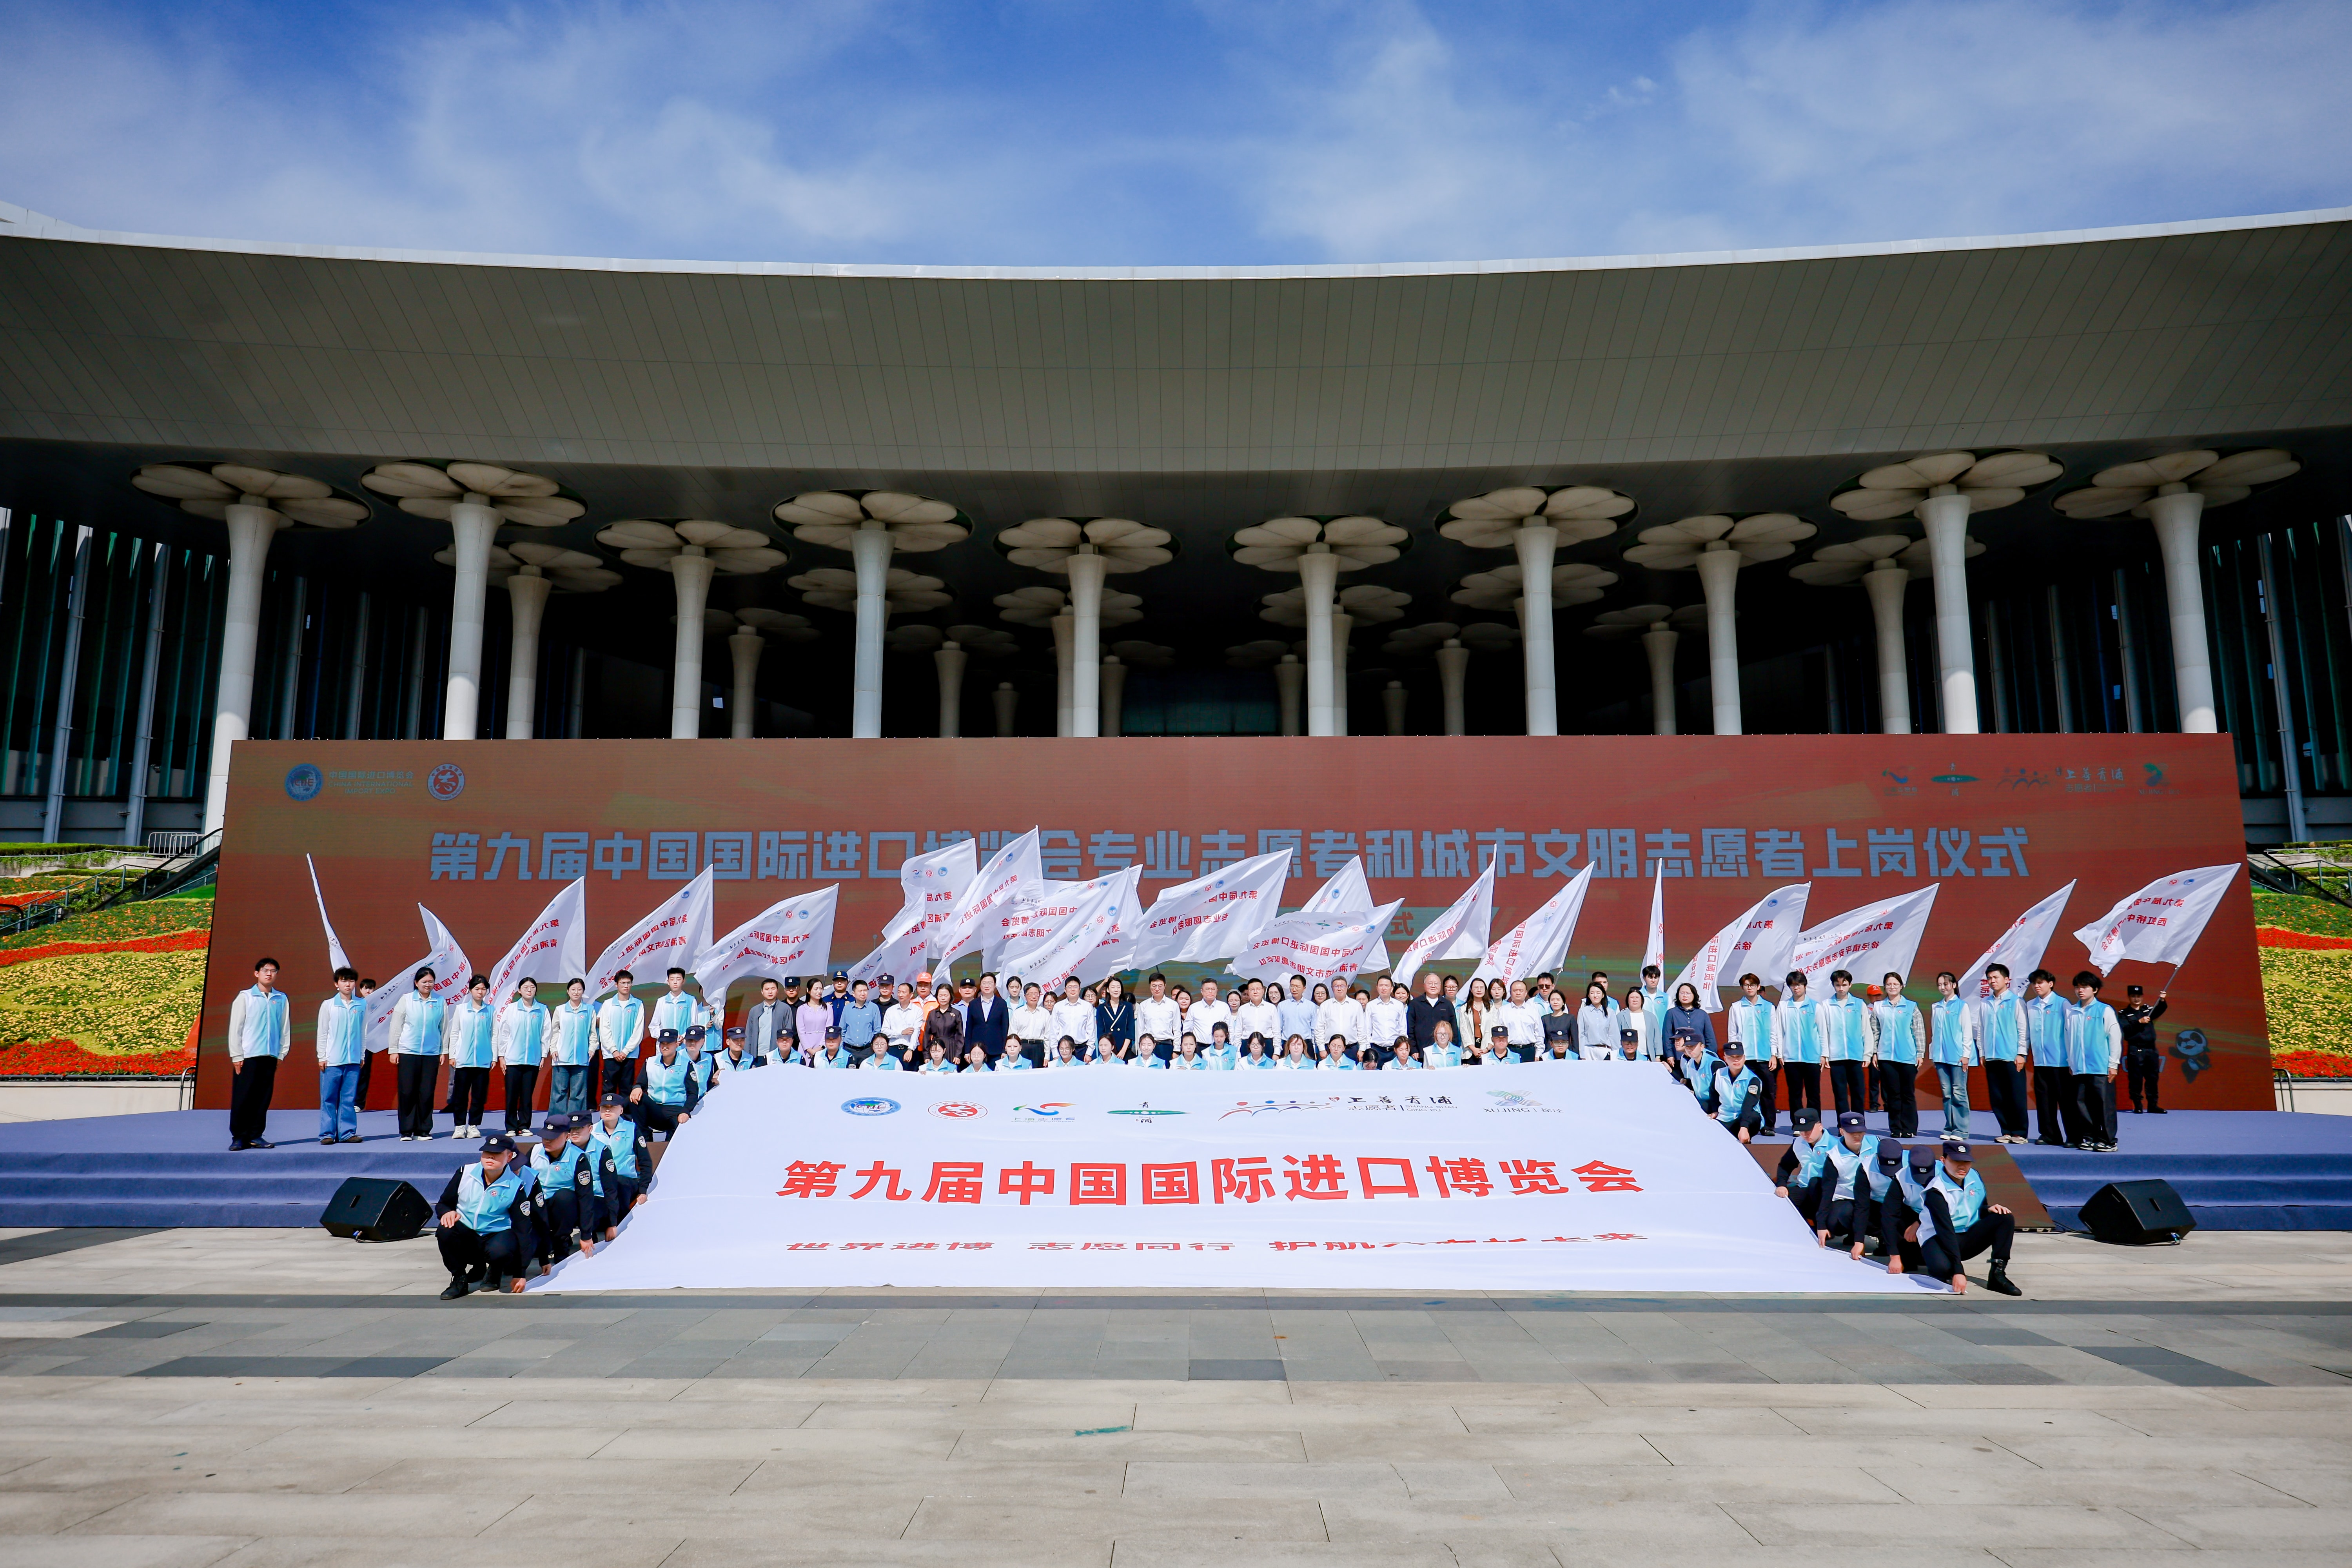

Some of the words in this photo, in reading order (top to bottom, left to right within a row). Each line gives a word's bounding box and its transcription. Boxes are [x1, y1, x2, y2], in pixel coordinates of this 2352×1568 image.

[2065, 767, 2123, 782] 上善青浦
[1347, 1096, 1452, 1104] 上善青浦
[775, 1156, 1644, 1206] 第九届中国国际进口博览会
[786, 1242, 995, 1250] 世界进博
[1027, 1242, 1236, 1250] 志愿同行
